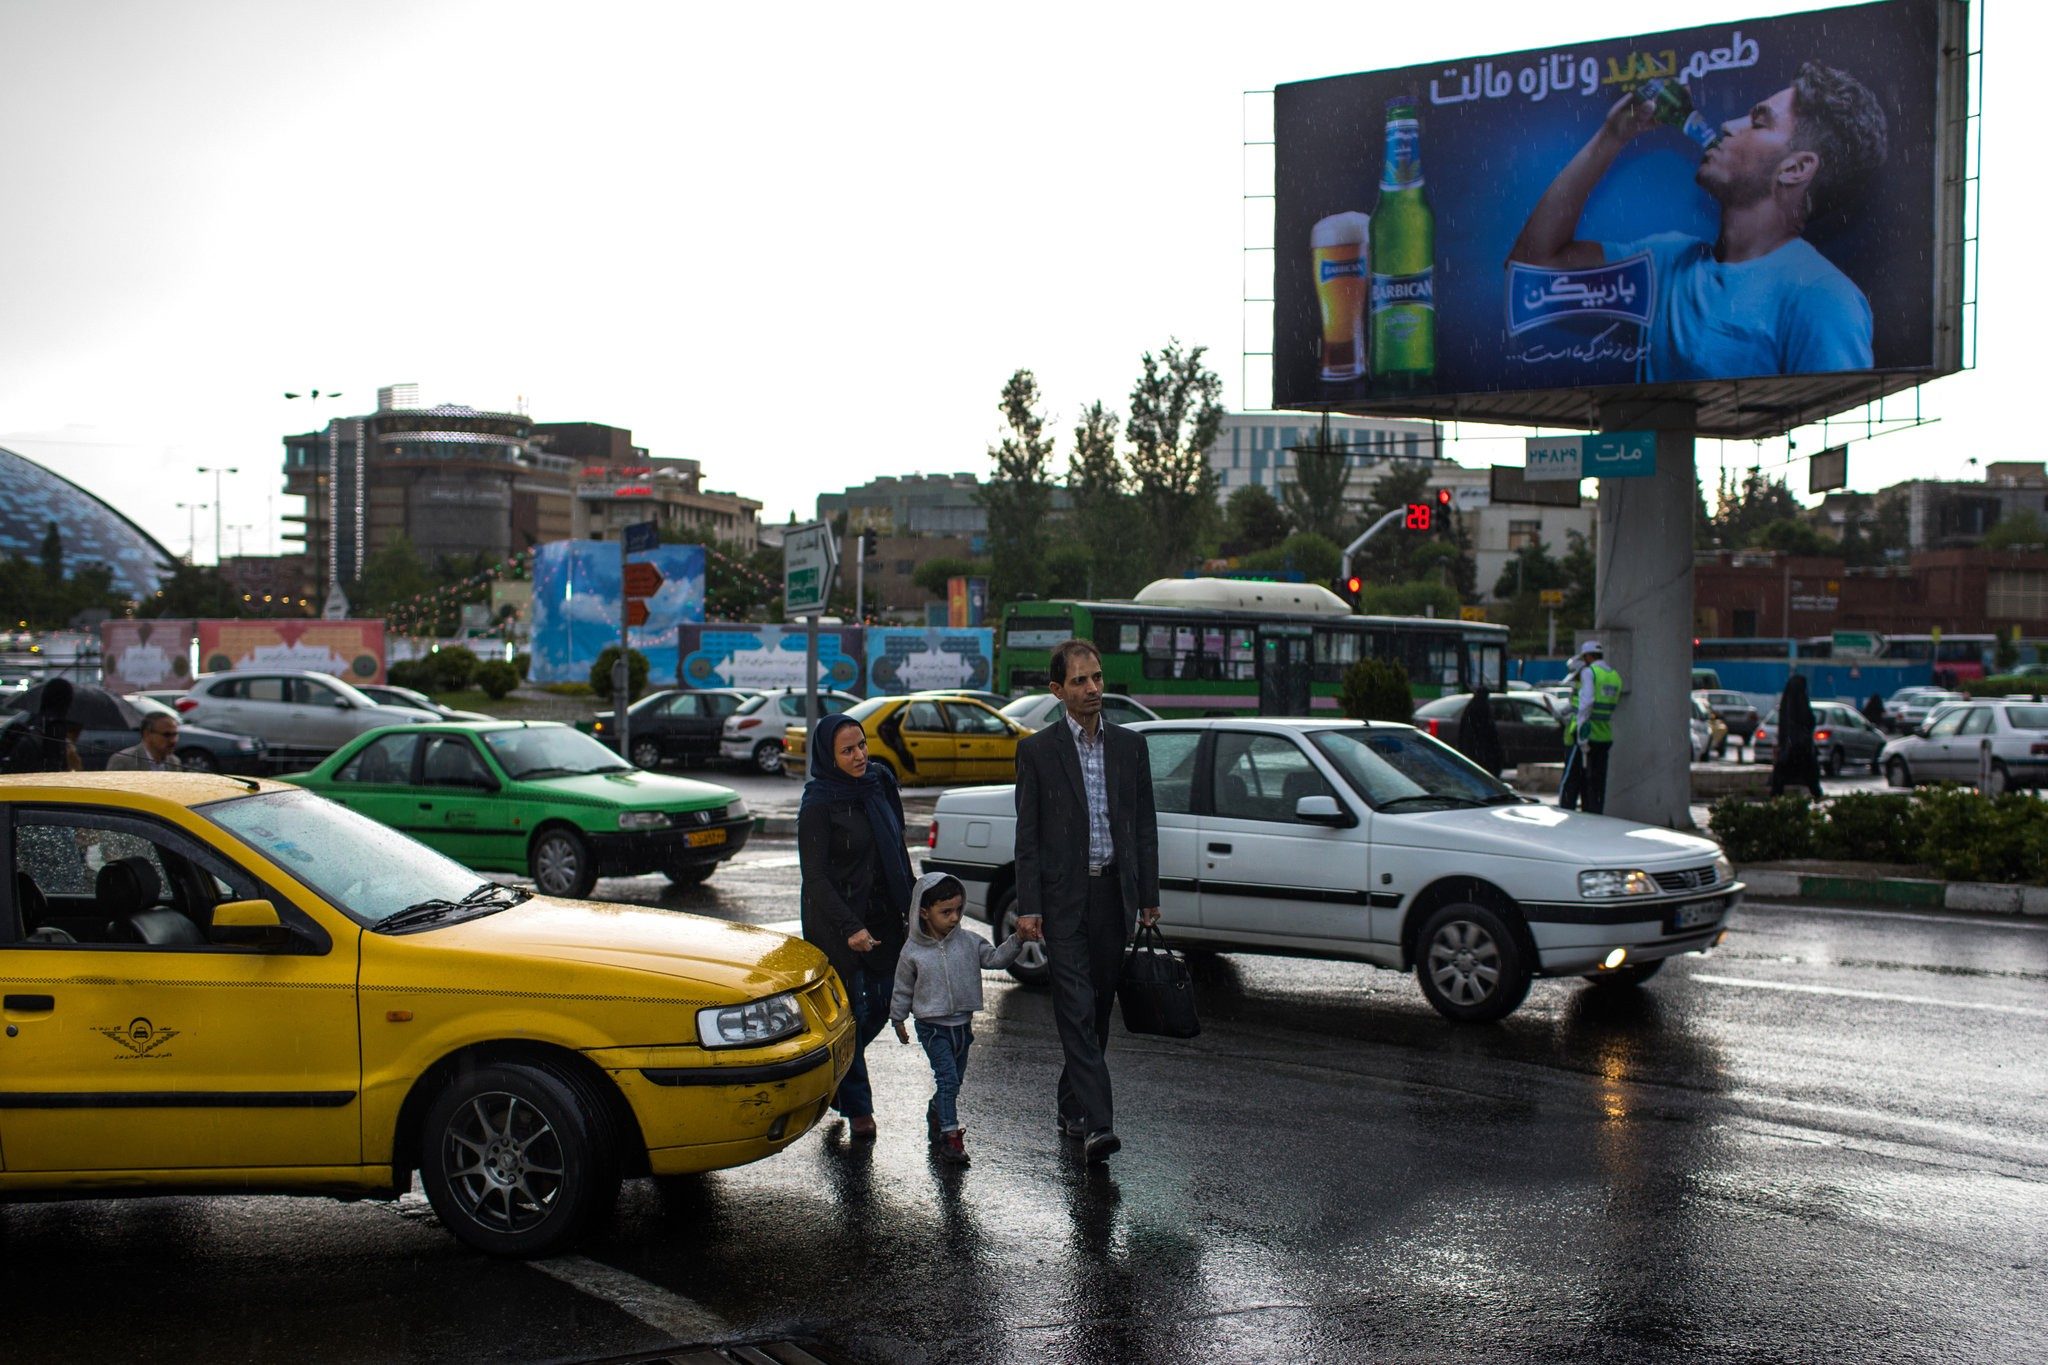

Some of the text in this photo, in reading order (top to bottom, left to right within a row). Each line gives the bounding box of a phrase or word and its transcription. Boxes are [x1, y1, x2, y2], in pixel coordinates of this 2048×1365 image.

[1679, 31, 1760, 85] طعم
[1430, 62, 1513, 105] مالت
[1371, 278, 1433, 301] BARBICAN
[1523, 273, 1636, 310] باربیکن
[1594, 443, 1643, 462] مات
[1406, 503, 1432, 530] 28
